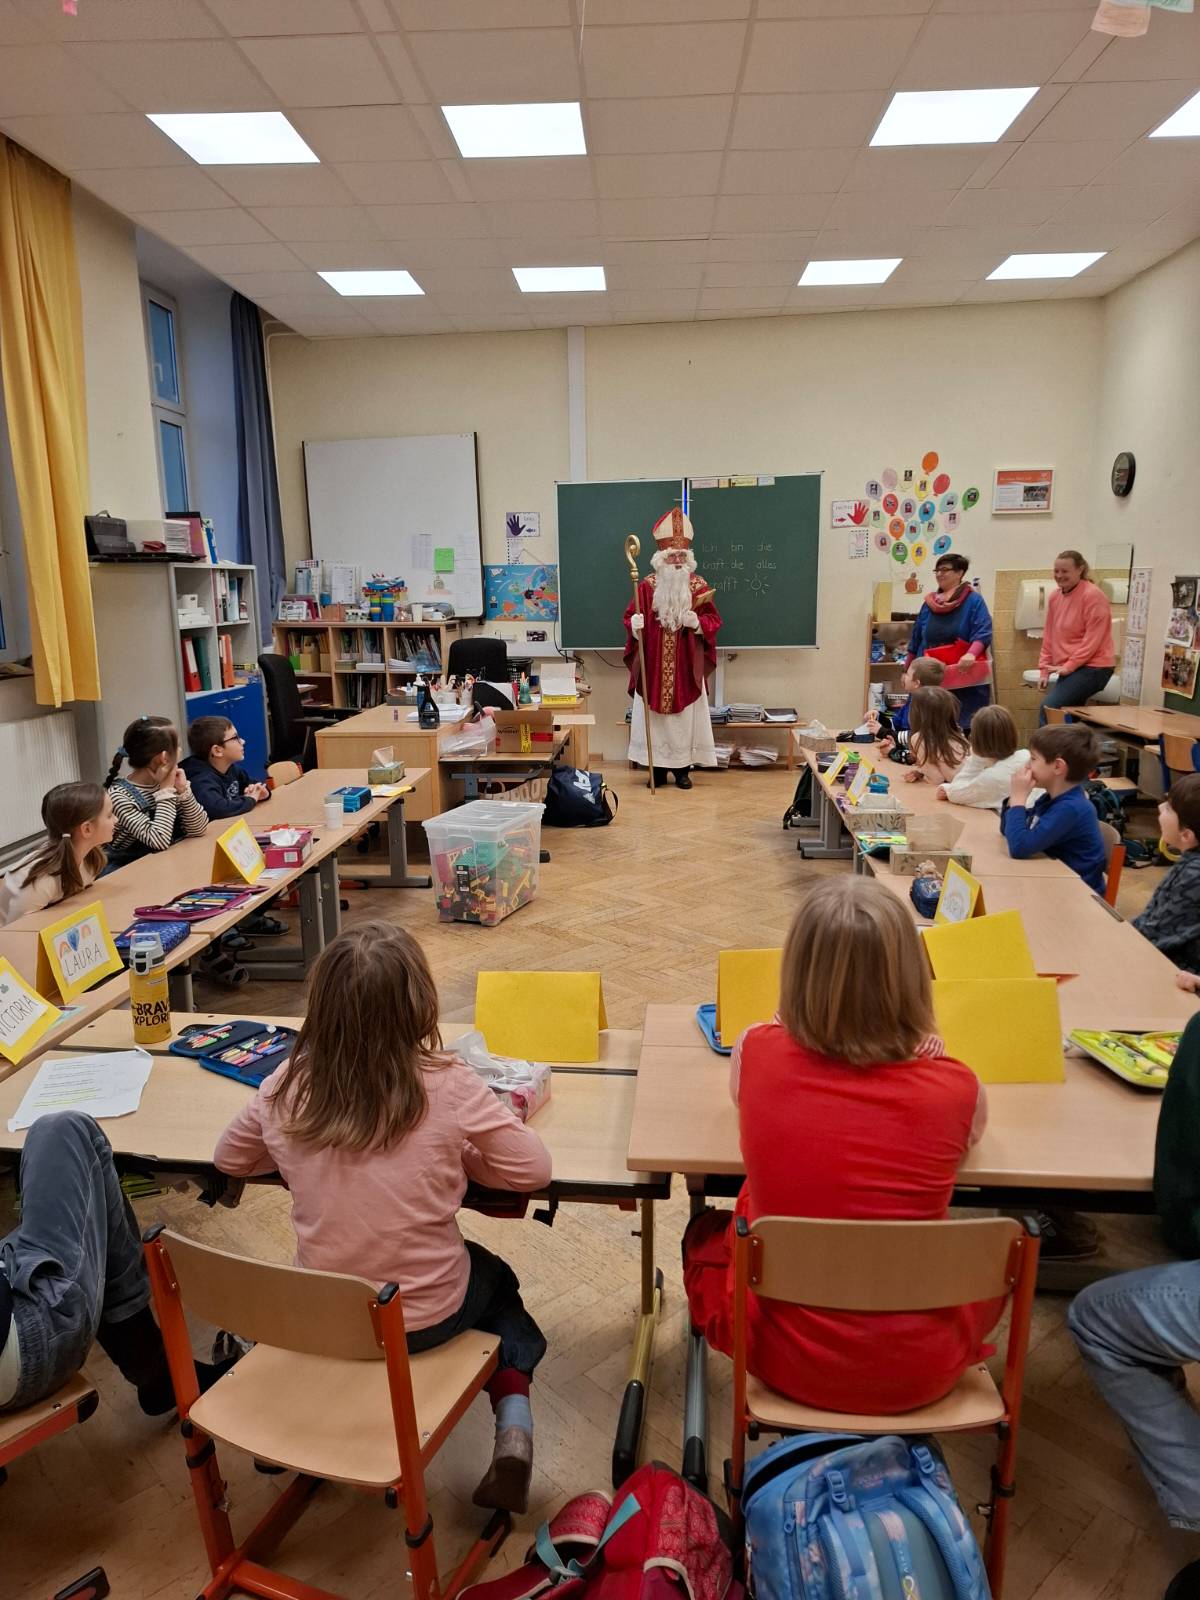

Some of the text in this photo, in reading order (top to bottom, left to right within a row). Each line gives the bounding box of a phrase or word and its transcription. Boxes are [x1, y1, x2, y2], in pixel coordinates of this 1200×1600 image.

[756, 559, 777, 570] alles
[64, 943, 103, 977] LAURA
[136, 1000, 168, 1016] BRAV
[133, 1012, 169, 1027] XPLOR
